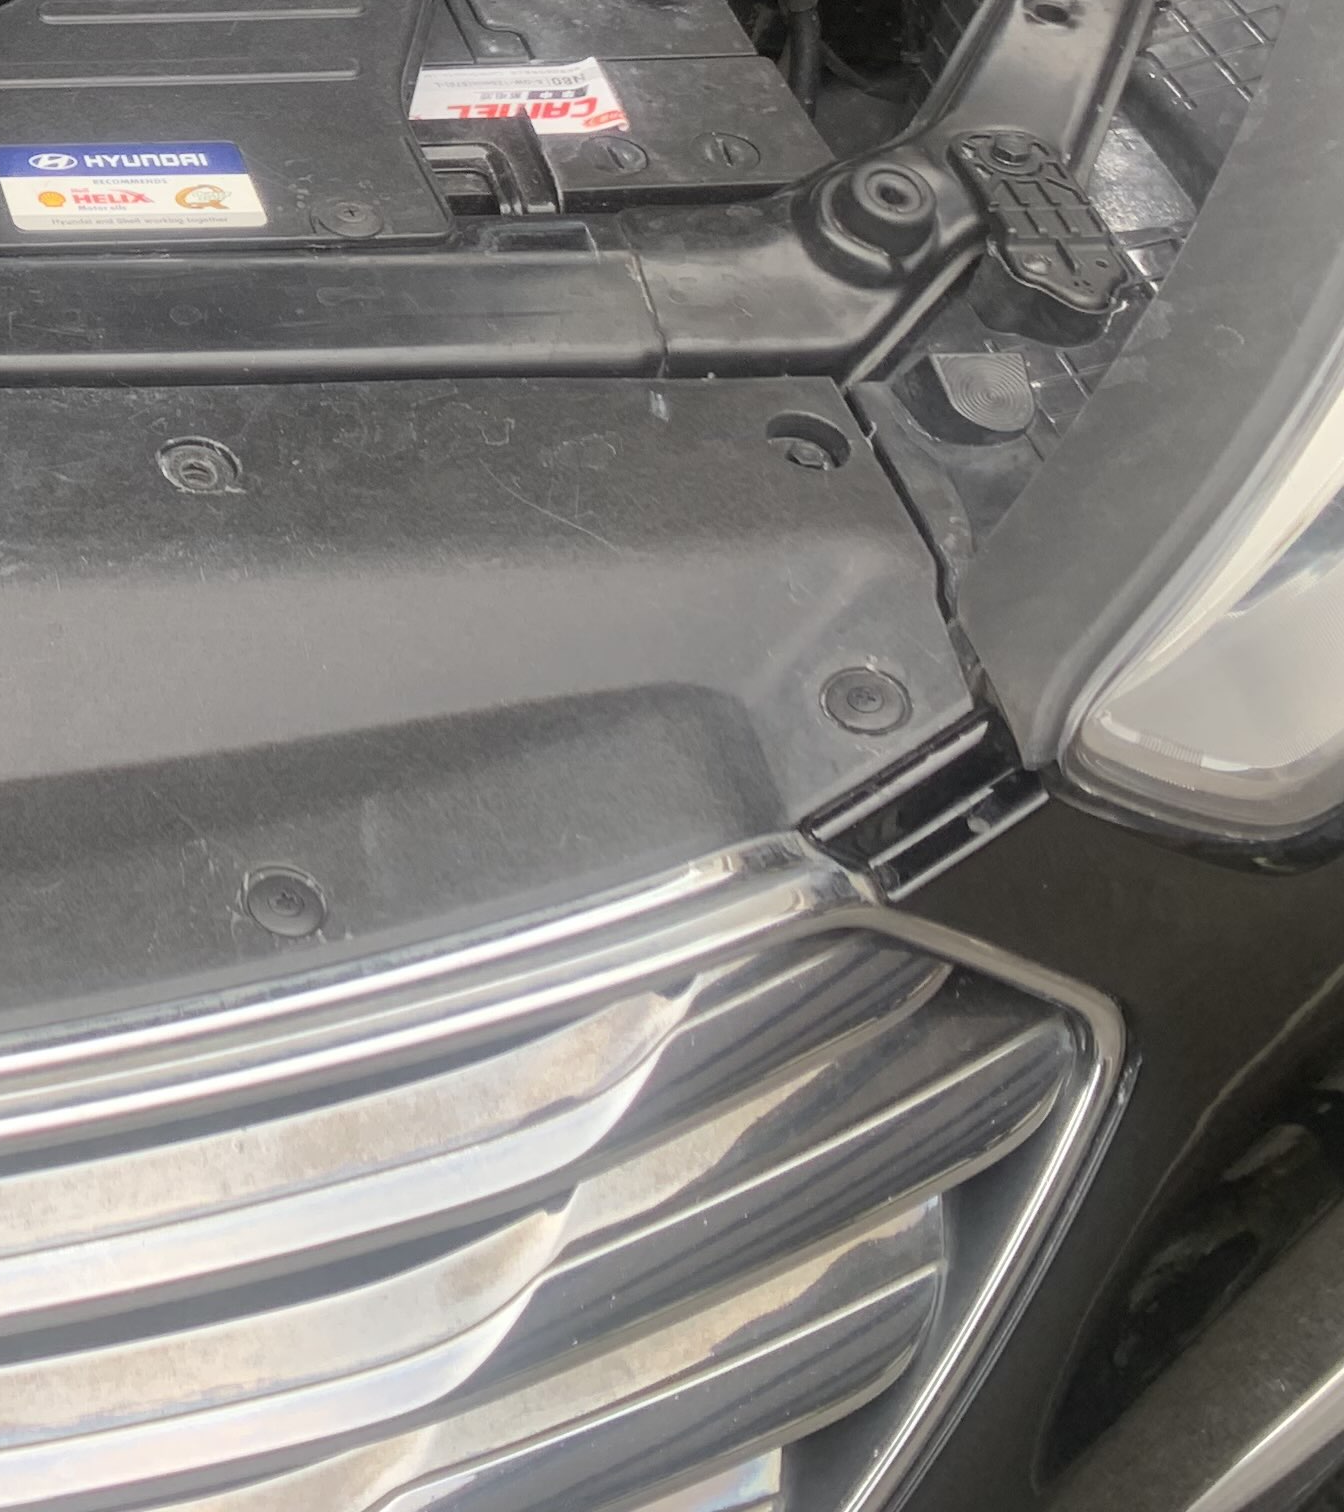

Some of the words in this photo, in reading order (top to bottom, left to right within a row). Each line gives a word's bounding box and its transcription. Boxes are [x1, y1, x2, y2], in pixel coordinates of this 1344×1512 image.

[448, 97, 598, 119] CAMEL
[84, 153, 208, 168] HYUNDAI
[73, 192, 150, 204] HELIX
